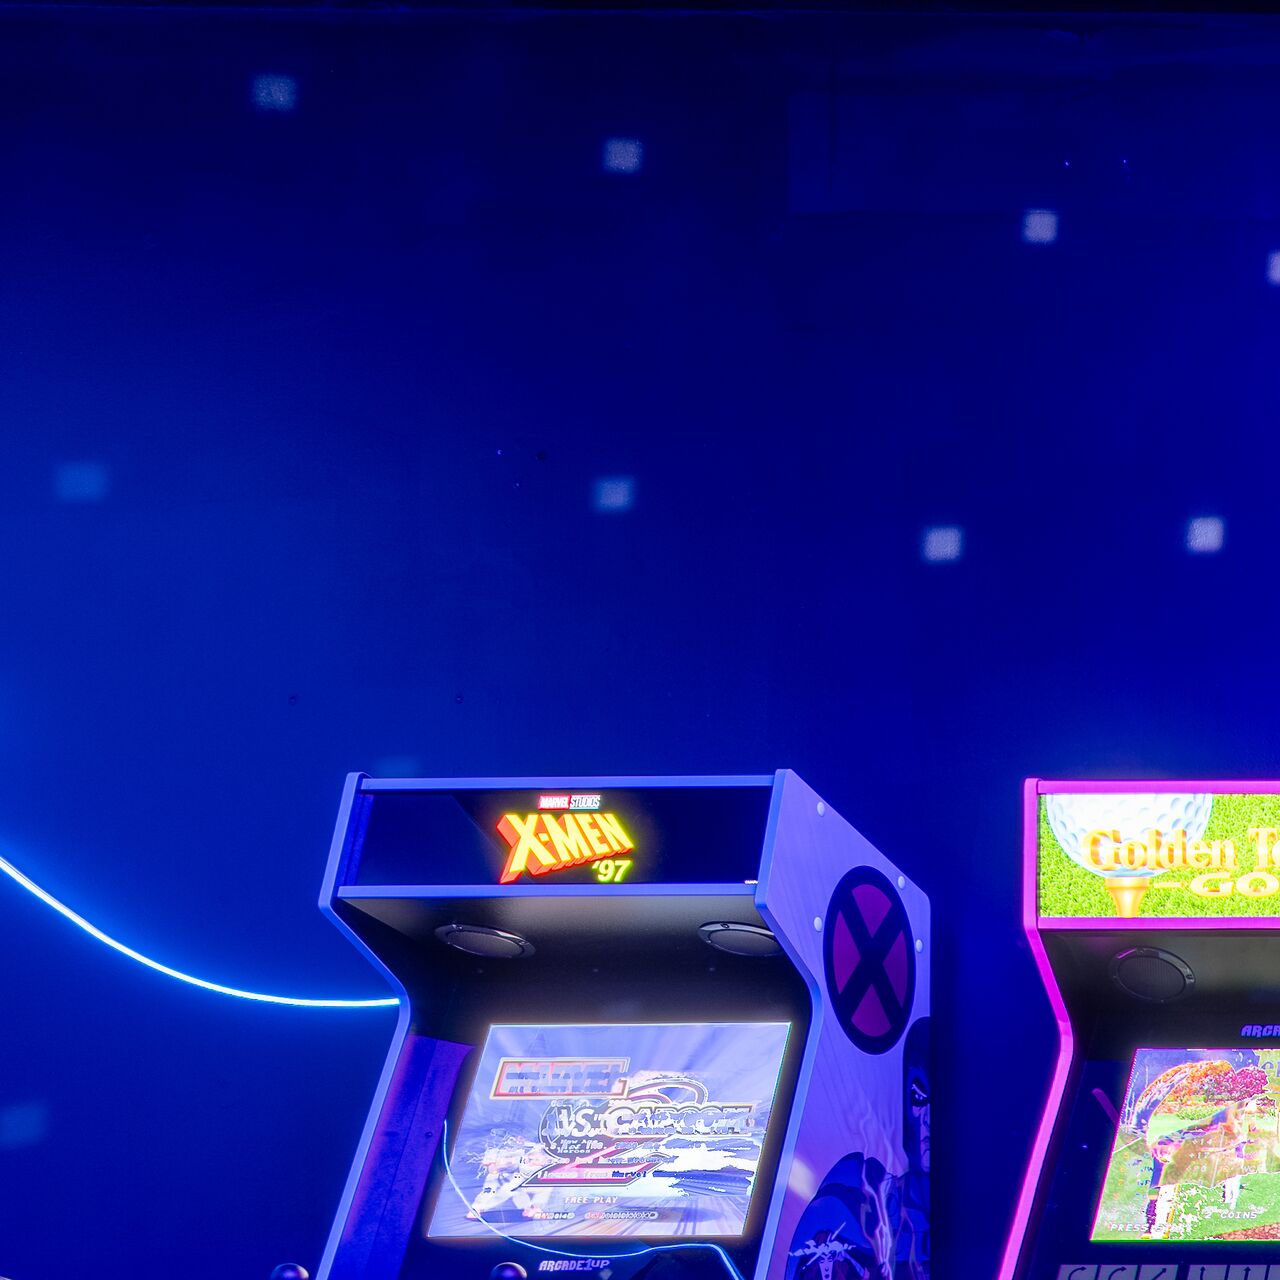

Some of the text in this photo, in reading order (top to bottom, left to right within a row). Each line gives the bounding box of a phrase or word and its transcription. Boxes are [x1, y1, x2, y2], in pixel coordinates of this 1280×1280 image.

[570, 796, 600, 809] STUDIOS
[496, 813, 635, 884] X-MEN
[1083, 828, 1236, 872] Golden
[592, 859, 632, 882] '97
[565, 1196, 618, 1205] FREE PLAY
[1220, 1211, 1258, 1219] COINS
[539, 1259, 611, 1272] ARCADE1UP
